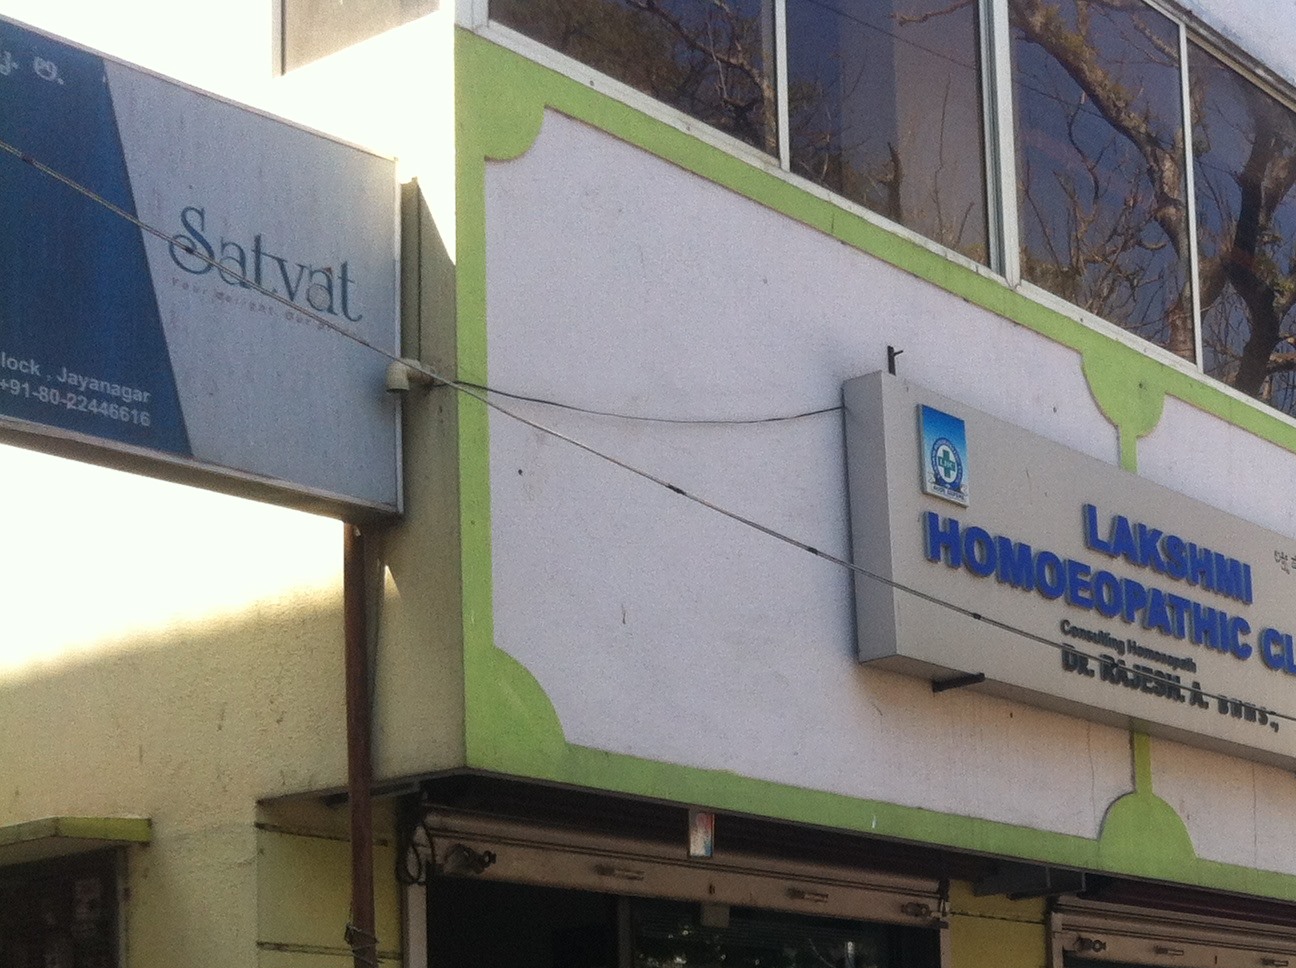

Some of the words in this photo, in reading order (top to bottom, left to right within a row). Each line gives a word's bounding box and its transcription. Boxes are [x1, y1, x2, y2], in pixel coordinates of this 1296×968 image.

[168, 206, 363, 322] Satvat
[57, 366, 152, 403] Jayanagar
[923, 511, 1253, 661] HOMOEOPATHIC
[1081, 502, 1253, 604] LAKSHMI
[1060, 619, 1126, 656] Consulting
